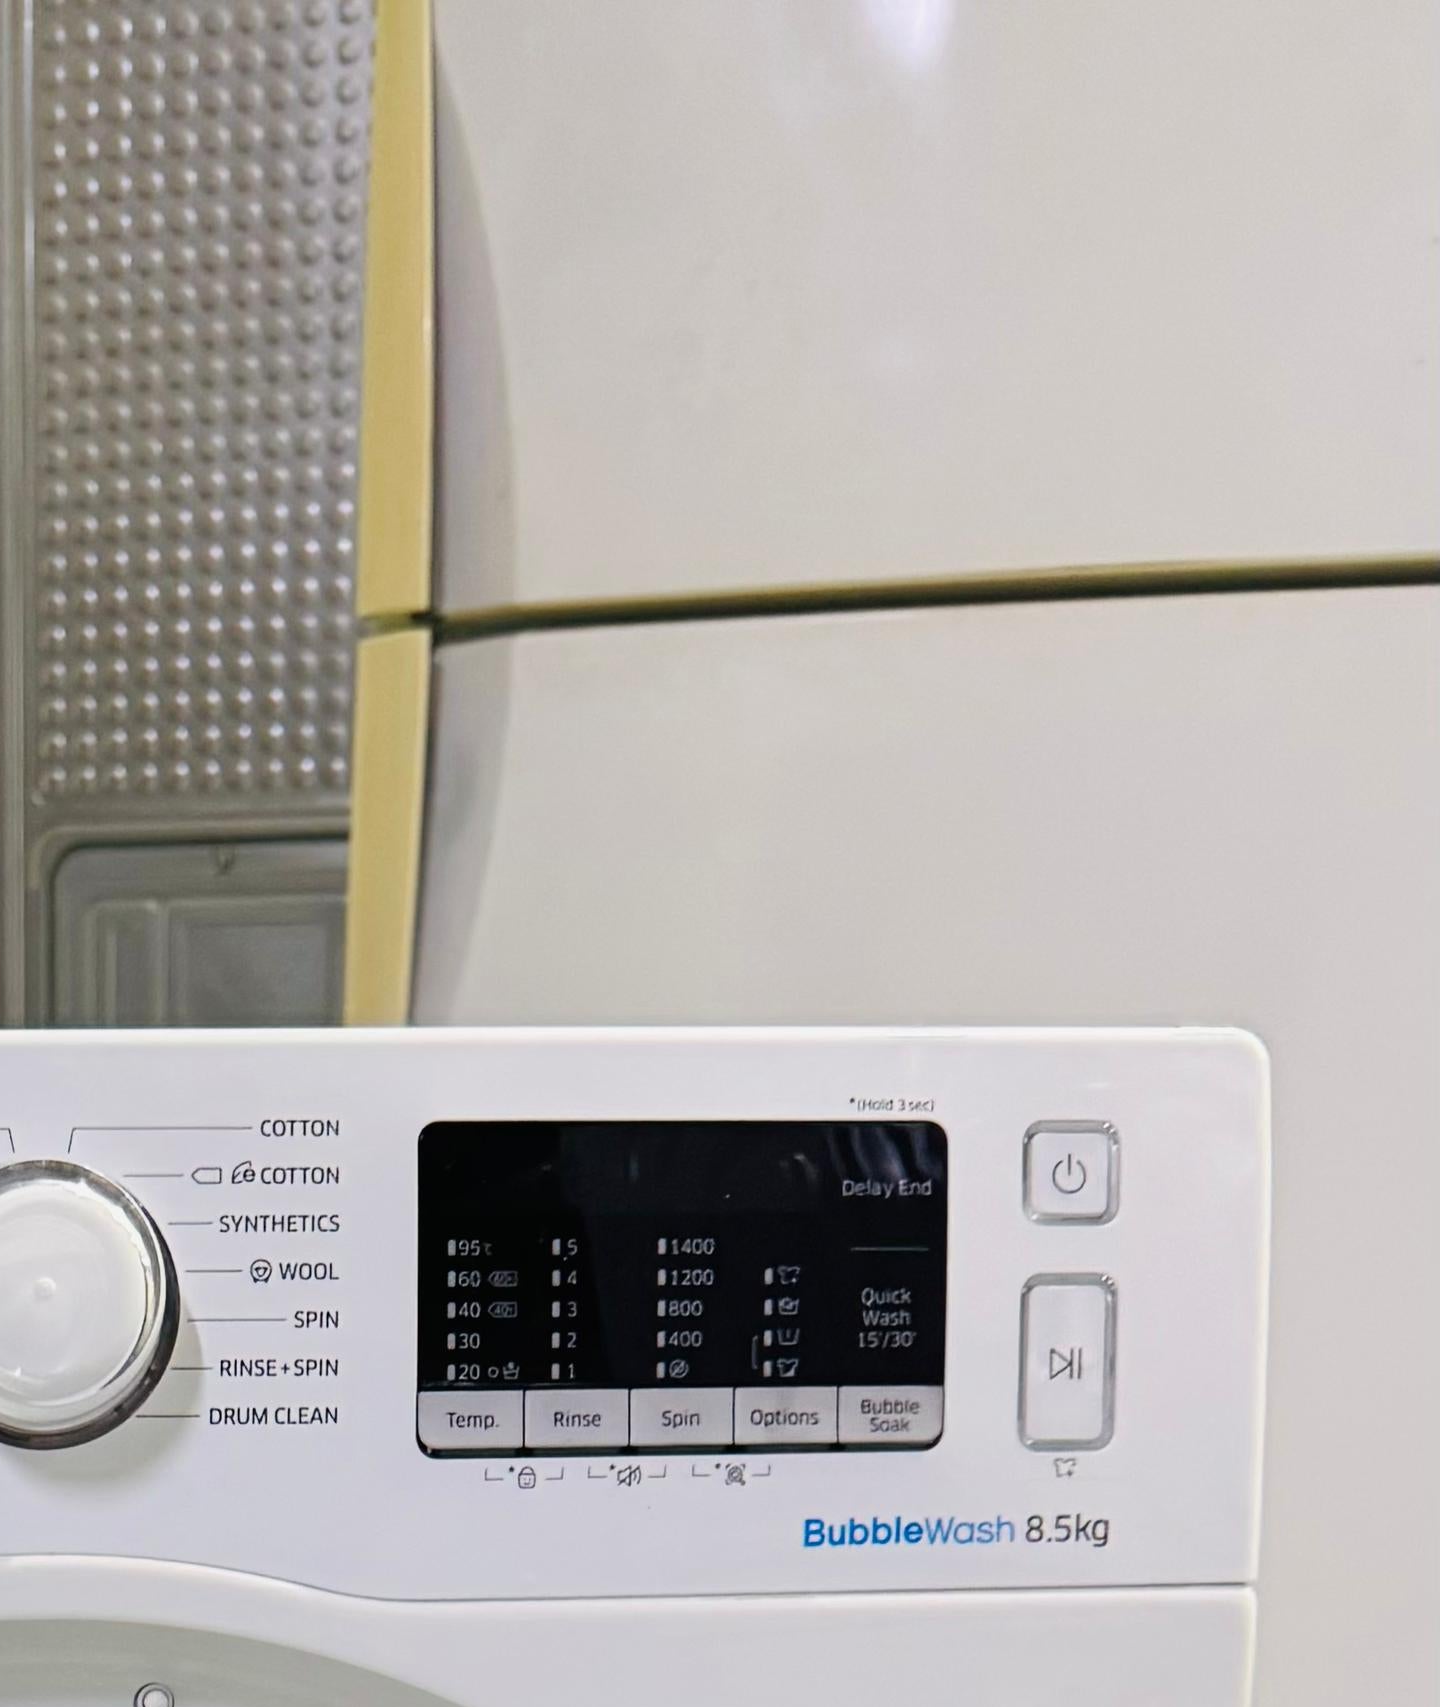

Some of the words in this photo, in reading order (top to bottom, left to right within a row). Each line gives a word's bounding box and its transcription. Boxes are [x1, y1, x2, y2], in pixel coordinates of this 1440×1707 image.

[260, 1120, 339, 1137] COTTON
[261, 1167, 339, 1184] COTTON
[842, 1179, 894, 1198] Delay
[899, 1179, 932, 1195] End
[220, 1214, 340, 1233] SYNTHETICS
[568, 1239, 578, 1255] 5
[671, 1238, 715, 1254] 1400
[279, 1262, 339, 1280] WOOL
[458, 1270, 481, 1287] 60
[568, 1270, 577, 1285] 4
[671, 1269, 714, 1285] 1200
[862, 1287, 911, 1306] Quick
[459, 1302, 481, 1318] 40
[568, 1301, 577, 1317] 3
[668, 1300, 703, 1316] 800
[294, 1311, 338, 1328] SPIN
[862, 1309, 911, 1326] Wash
[459, 1333, 480, 1349] 30
[568, 1332, 577, 1348] 2
[668, 1331, 702, 1347] 400
[458, 1364, 480, 1380] 20
[568, 1363, 575, 1379] 1
[861, 1399, 920, 1415] Bubble
[209, 1407, 268, 1425] DRUM
[274, 1407, 338, 1424] CLEAN
[446, 1410, 499, 1432] Temp.
[553, 1409, 601, 1429] Rinse
[661, 1409, 701, 1430] Spin
[750, 1407, 819, 1429] Options
[870, 1417, 910, 1432] Soak
[803, 1515, 1015, 1548] BubbleWash
[1025, 1514, 1110, 1548] 8.5kg
